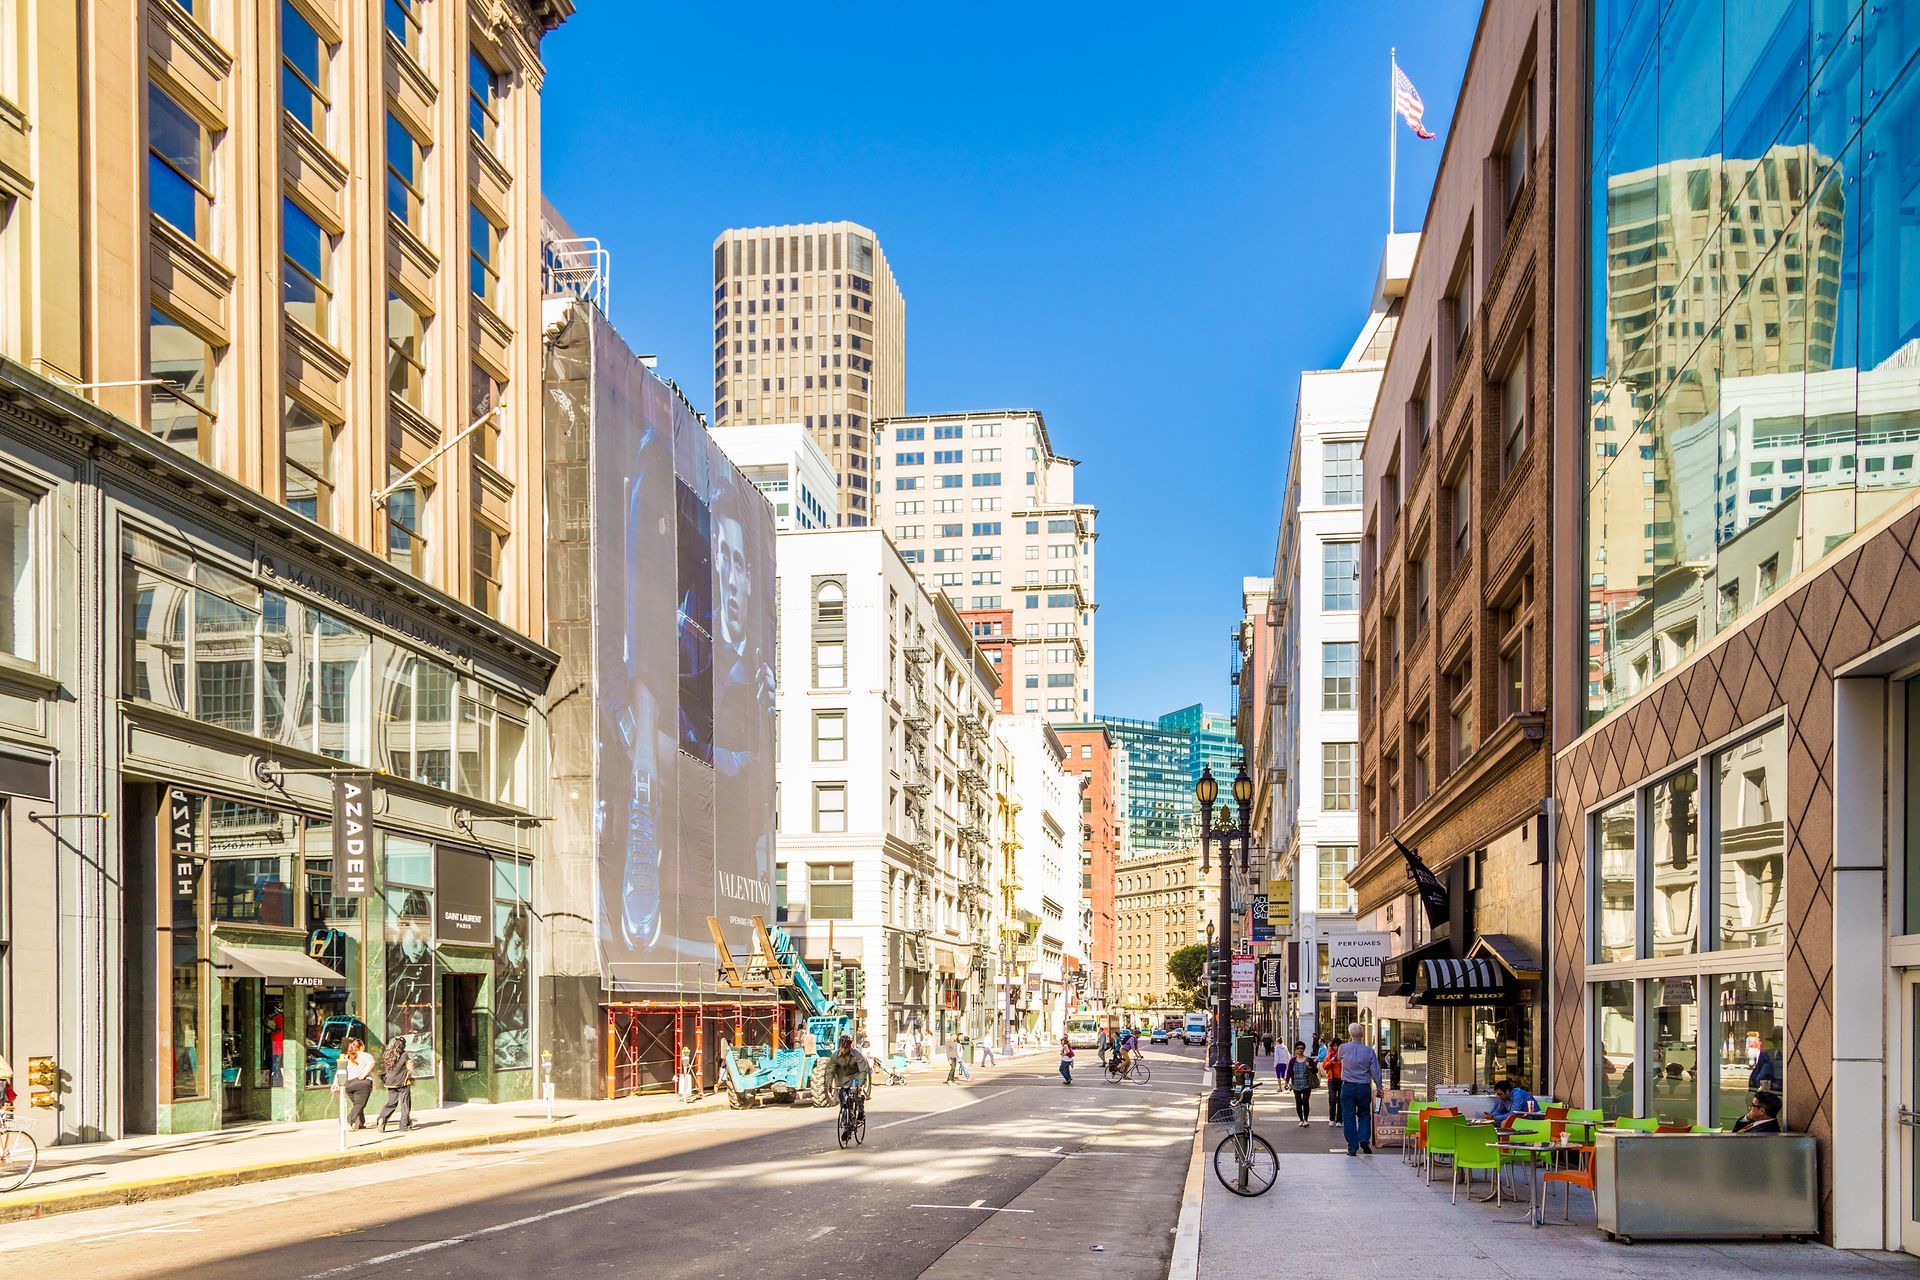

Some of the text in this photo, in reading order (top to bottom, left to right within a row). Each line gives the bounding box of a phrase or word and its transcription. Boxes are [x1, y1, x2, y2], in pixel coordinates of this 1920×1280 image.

[288, 564, 452, 655] MARION BUILDING
[344, 782, 365, 893] AZADEH
[719, 870, 771, 905] VALENTINO
[444, 911, 482, 923] SAINT LAURENT
[729, 915, 747, 926] OPENING
[293, 977, 322, 986] AZADEH
[1268, 960, 1280, 996] VILEBREQUIN
[1379, 1127, 1405, 1136] OPE
